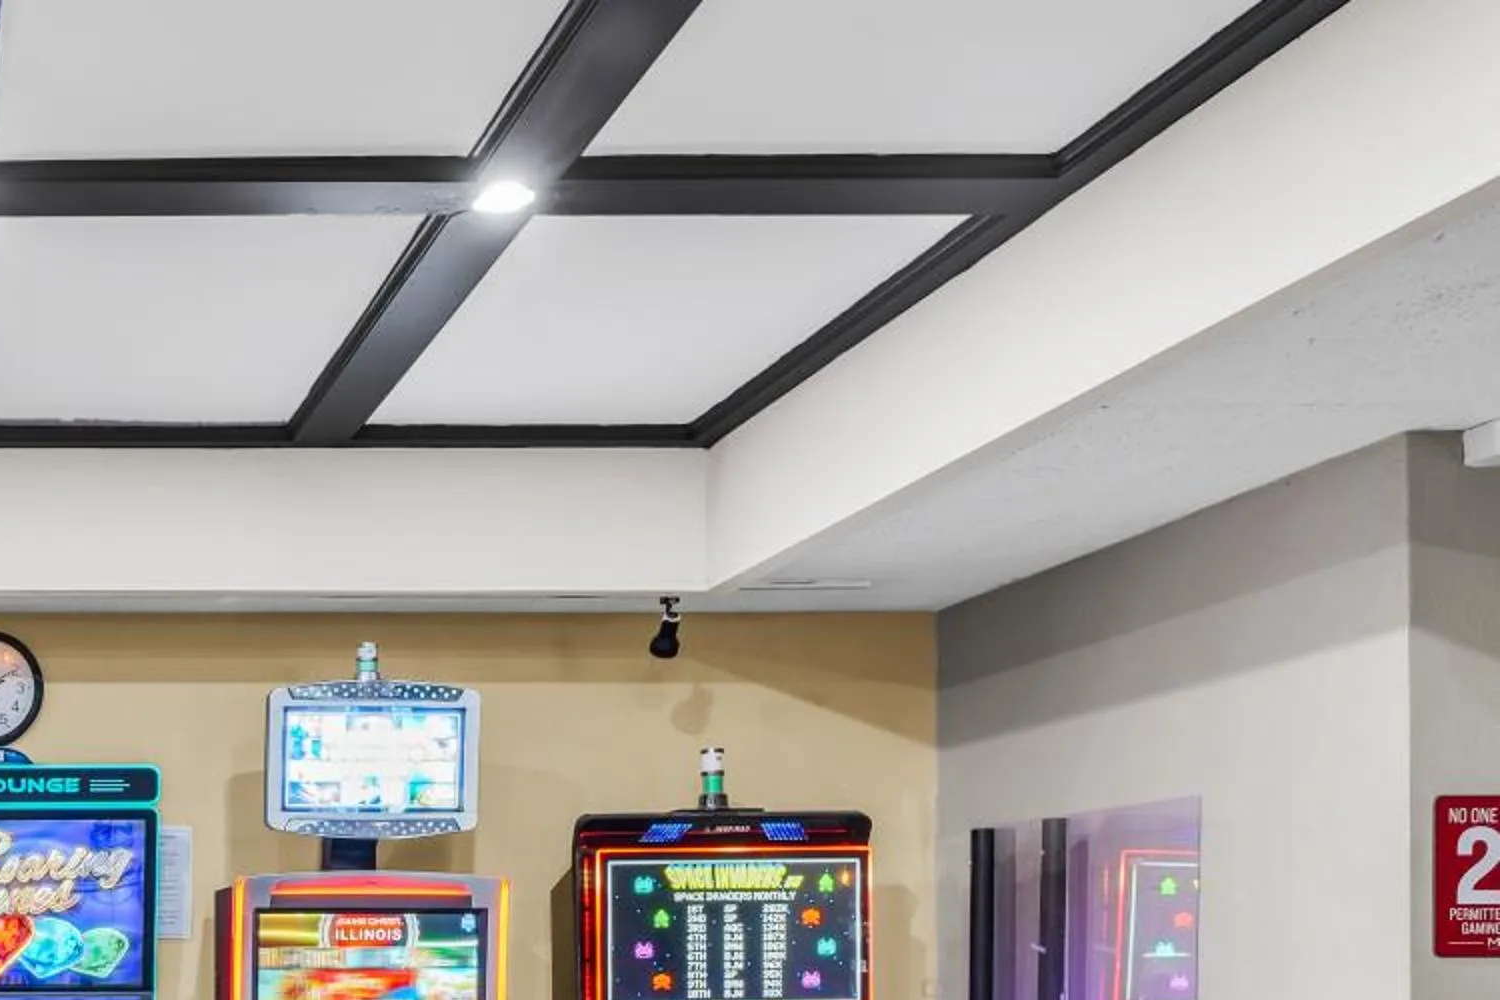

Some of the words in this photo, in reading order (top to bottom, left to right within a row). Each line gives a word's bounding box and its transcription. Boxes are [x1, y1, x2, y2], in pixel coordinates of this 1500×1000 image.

[11, 700, 19, 712] 4
[1448, 808, 1467, 823] NO
[1471, 808, 1499, 824] ONE
[335, 927, 402, 941] ILLINOIS
